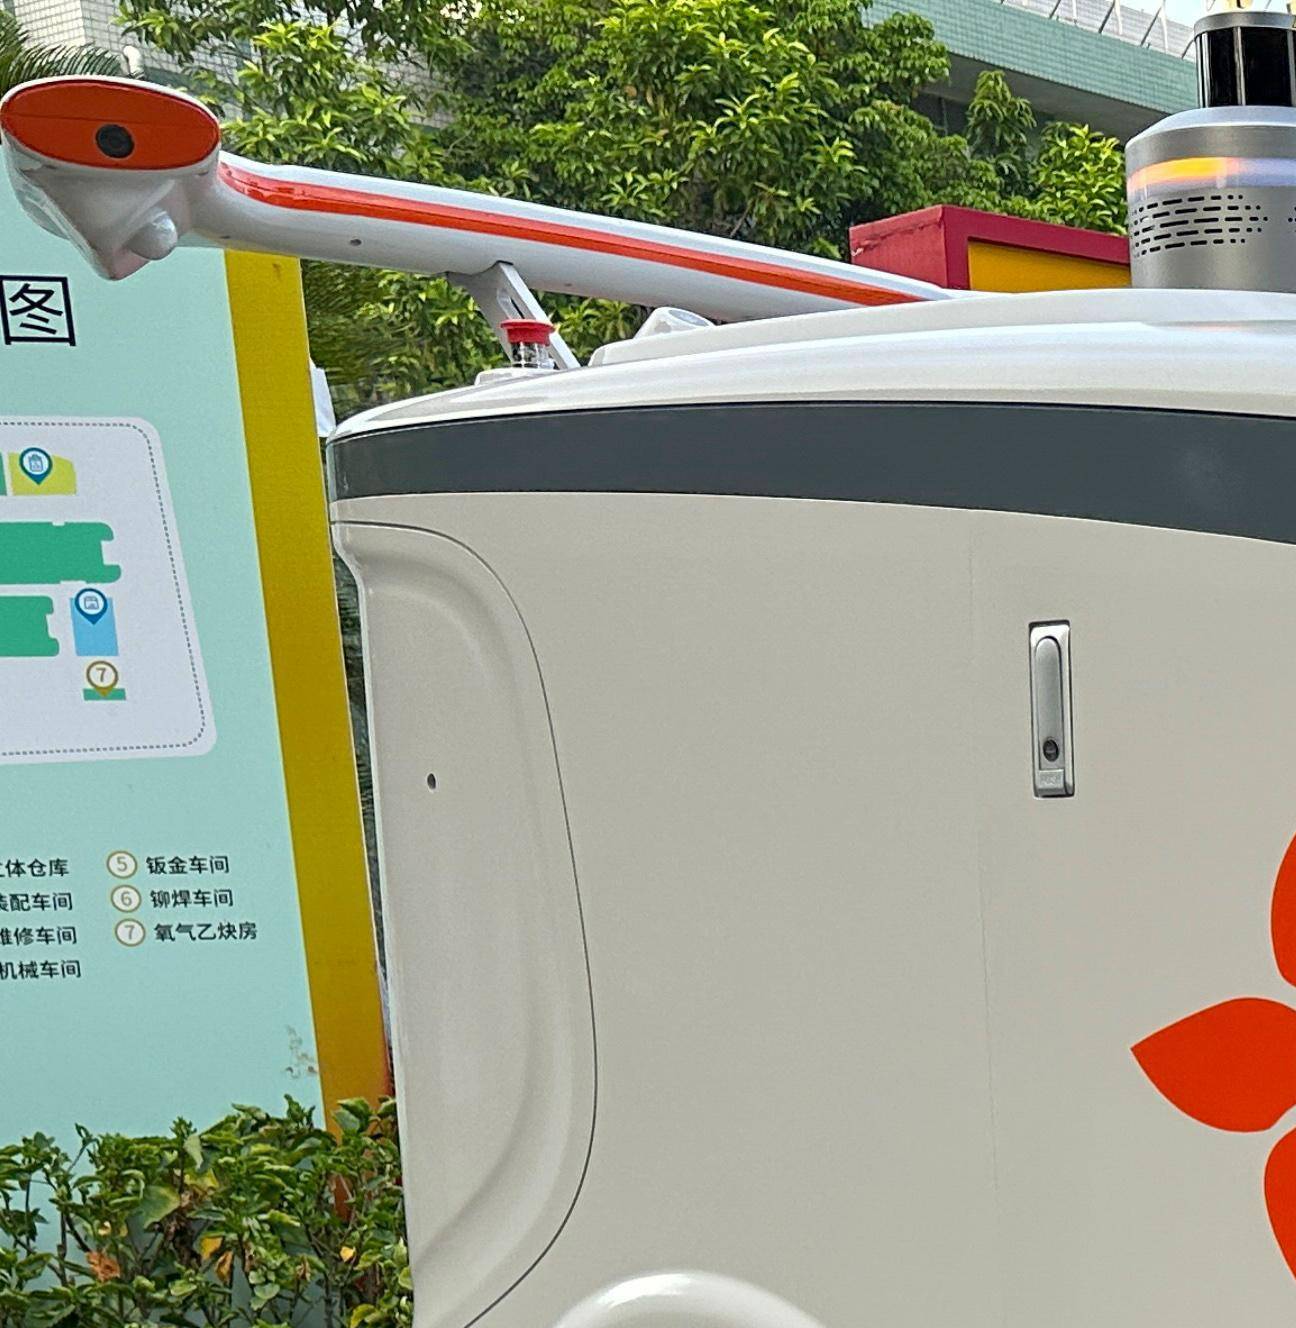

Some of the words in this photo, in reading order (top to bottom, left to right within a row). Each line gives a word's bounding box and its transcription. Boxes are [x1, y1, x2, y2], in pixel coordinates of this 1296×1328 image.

[0, 275, 76, 346] 图
[0, 859, 70, 878] 体仓库
[146, 856, 229, 874] 钣金车间
[154, 922, 257, 942] 氧气乙炔房
